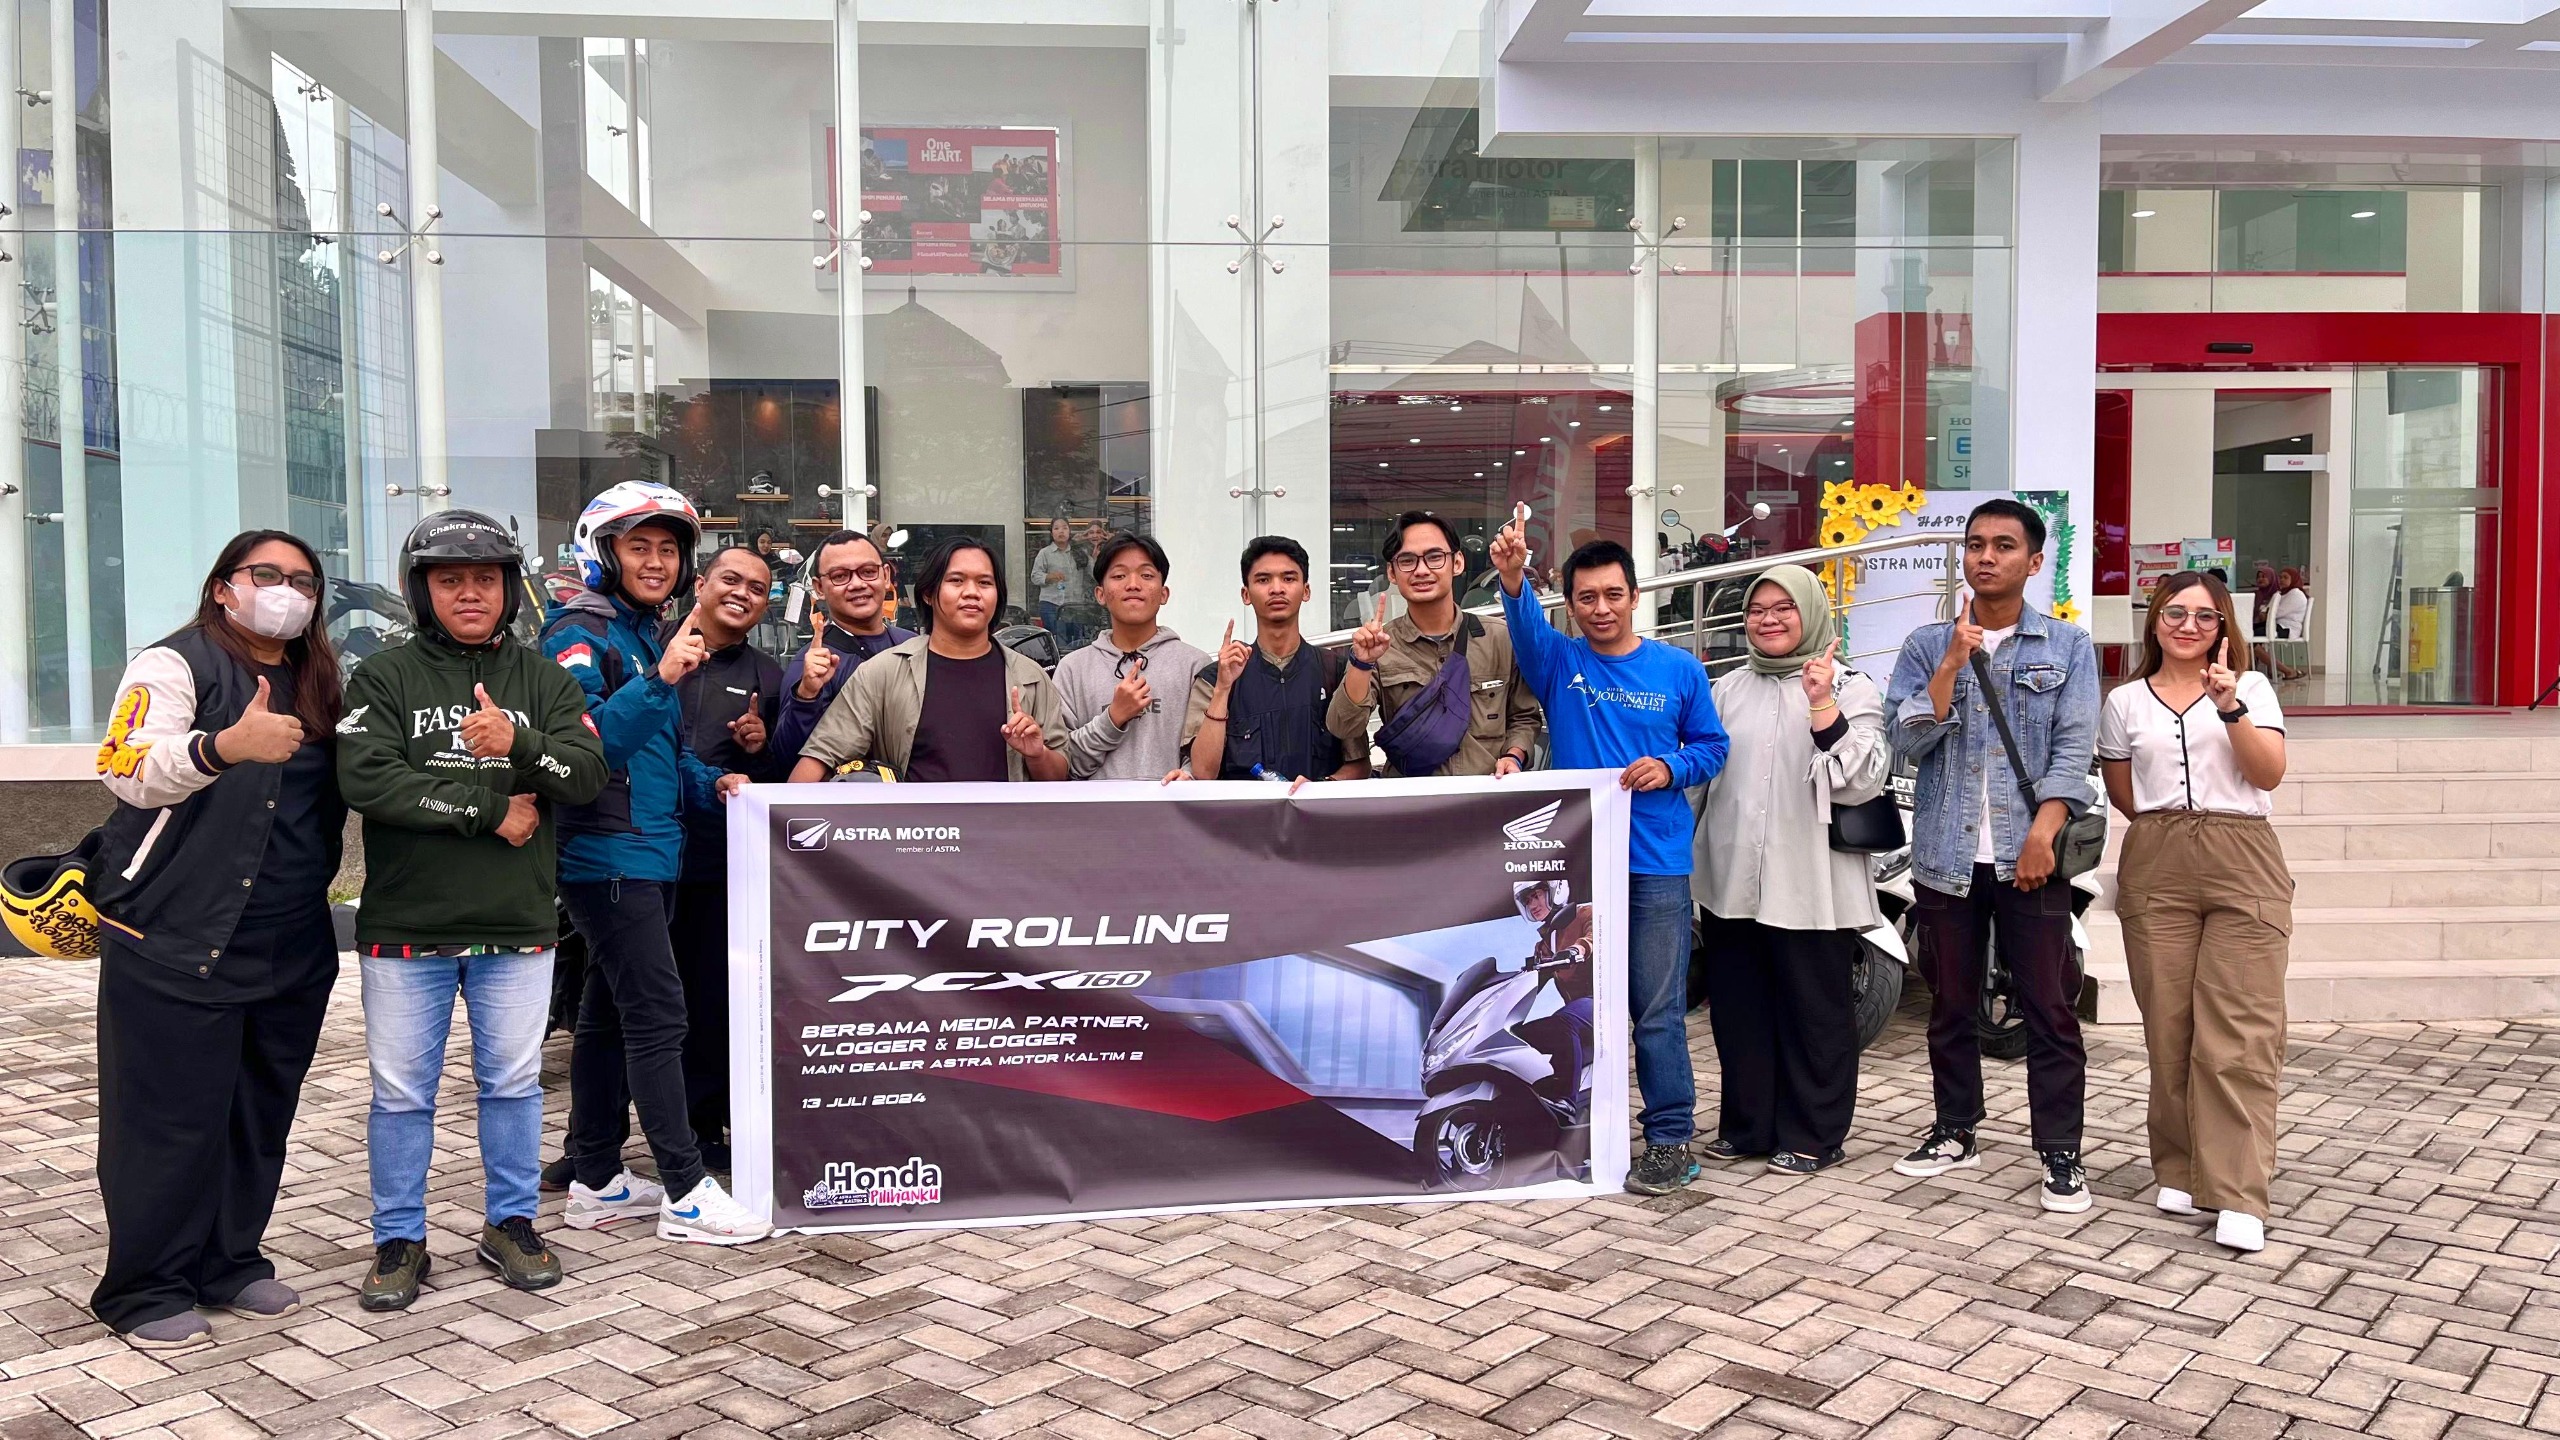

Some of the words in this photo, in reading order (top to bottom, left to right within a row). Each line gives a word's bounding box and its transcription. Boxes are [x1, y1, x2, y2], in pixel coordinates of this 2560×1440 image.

[926, 138, 951, 150] One
[921, 151, 962, 162] HEART.
[1476, 155, 1569, 178] motor
[1950, 418, 1971, 426] HO
[1954, 465, 1971, 478] SH
[1917, 515, 1966, 527] HAPP
[429, 522, 467, 537] Chakra
[1864, 557, 1907, 570] STRA
[2194, 558, 2223, 568] ASTRA
[1598, 690, 1667, 708] JOURNALIST
[832, 827, 892, 841] ASTRA
[896, 826, 961, 840] MOTOR
[926, 845, 933, 853] of
[934, 845, 960, 853] ASTRA
[1503, 840, 1566, 850] HONDA
[1505, 861, 1527, 873] One
[1529, 859, 1566, 872] HEART.
[803, 919, 948, 952] CITY
[966, 913, 1230, 949] ROLLING
[827, 969, 1080, 1003] PCX
[1076, 972, 1146, 988] 160
[801, 1020, 931, 1039] BERSAMA
[939, 1016, 1016, 1033] MEDIA
[1024, 1015, 1150, 1031] PARTNER,
[801, 1039, 927, 1057] VLOGGER
[935, 1038, 949, 1051] &
[956, 1033, 1077, 1050] BLOGGER
[801, 1063, 845, 1075] MAIN
[849, 1060, 925, 1073] DEALER
[929, 1056, 993, 1069] ASTRA
[998, 1053, 1059, 1066] MOTOR
[1063, 1051, 1126, 1063] KALTIM
[1129, 1051, 1144, 1061] 2
[802, 1098, 821, 1109] 13
[826, 1096, 867, 1108] JULI
[871, 1092, 927, 1106] 2024
[828, 1160, 939, 1191] Honda
